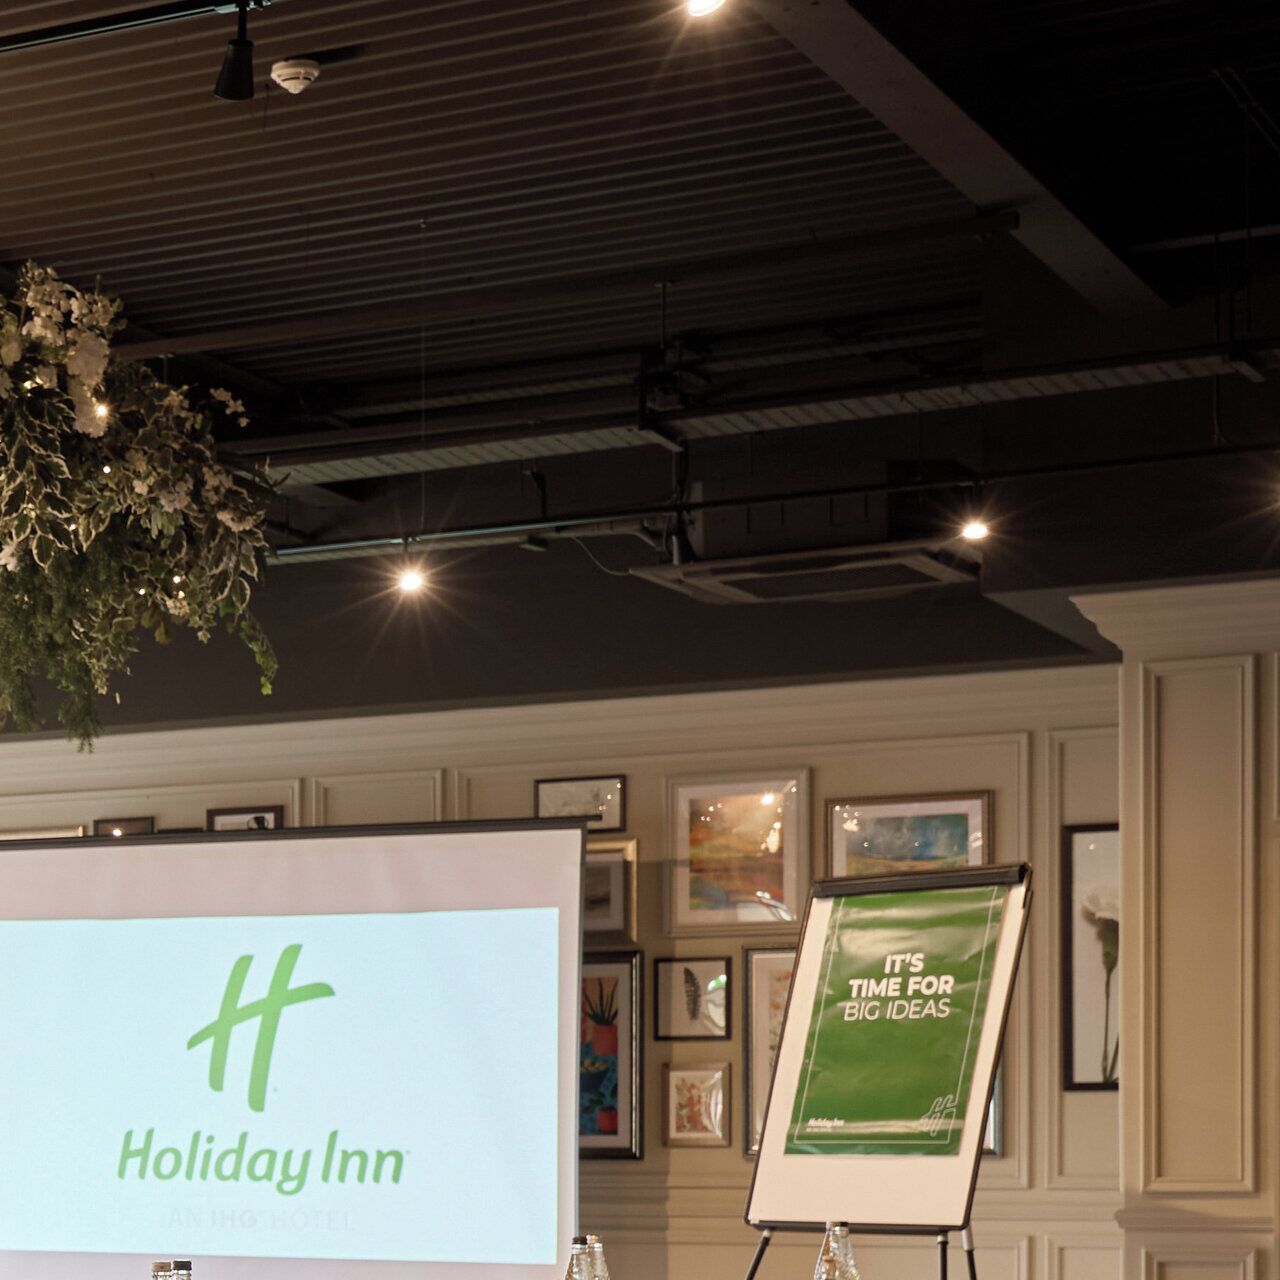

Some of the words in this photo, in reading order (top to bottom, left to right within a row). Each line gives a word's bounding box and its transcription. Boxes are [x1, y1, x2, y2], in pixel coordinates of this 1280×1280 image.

[884, 952, 925, 974] IT'S
[848, 976, 902, 999] TIME
[907, 974, 955, 997] FOR
[843, 1000, 880, 1022] BIG
[886, 997, 951, 1020] IDEAS
[116, 1127, 313, 1198] Holiday
[319, 1129, 405, 1185] Inn
[168, 1207, 203, 1228] AN
[210, 1208, 259, 1230] IHG
[270, 1209, 356, 1232] HOTEL
